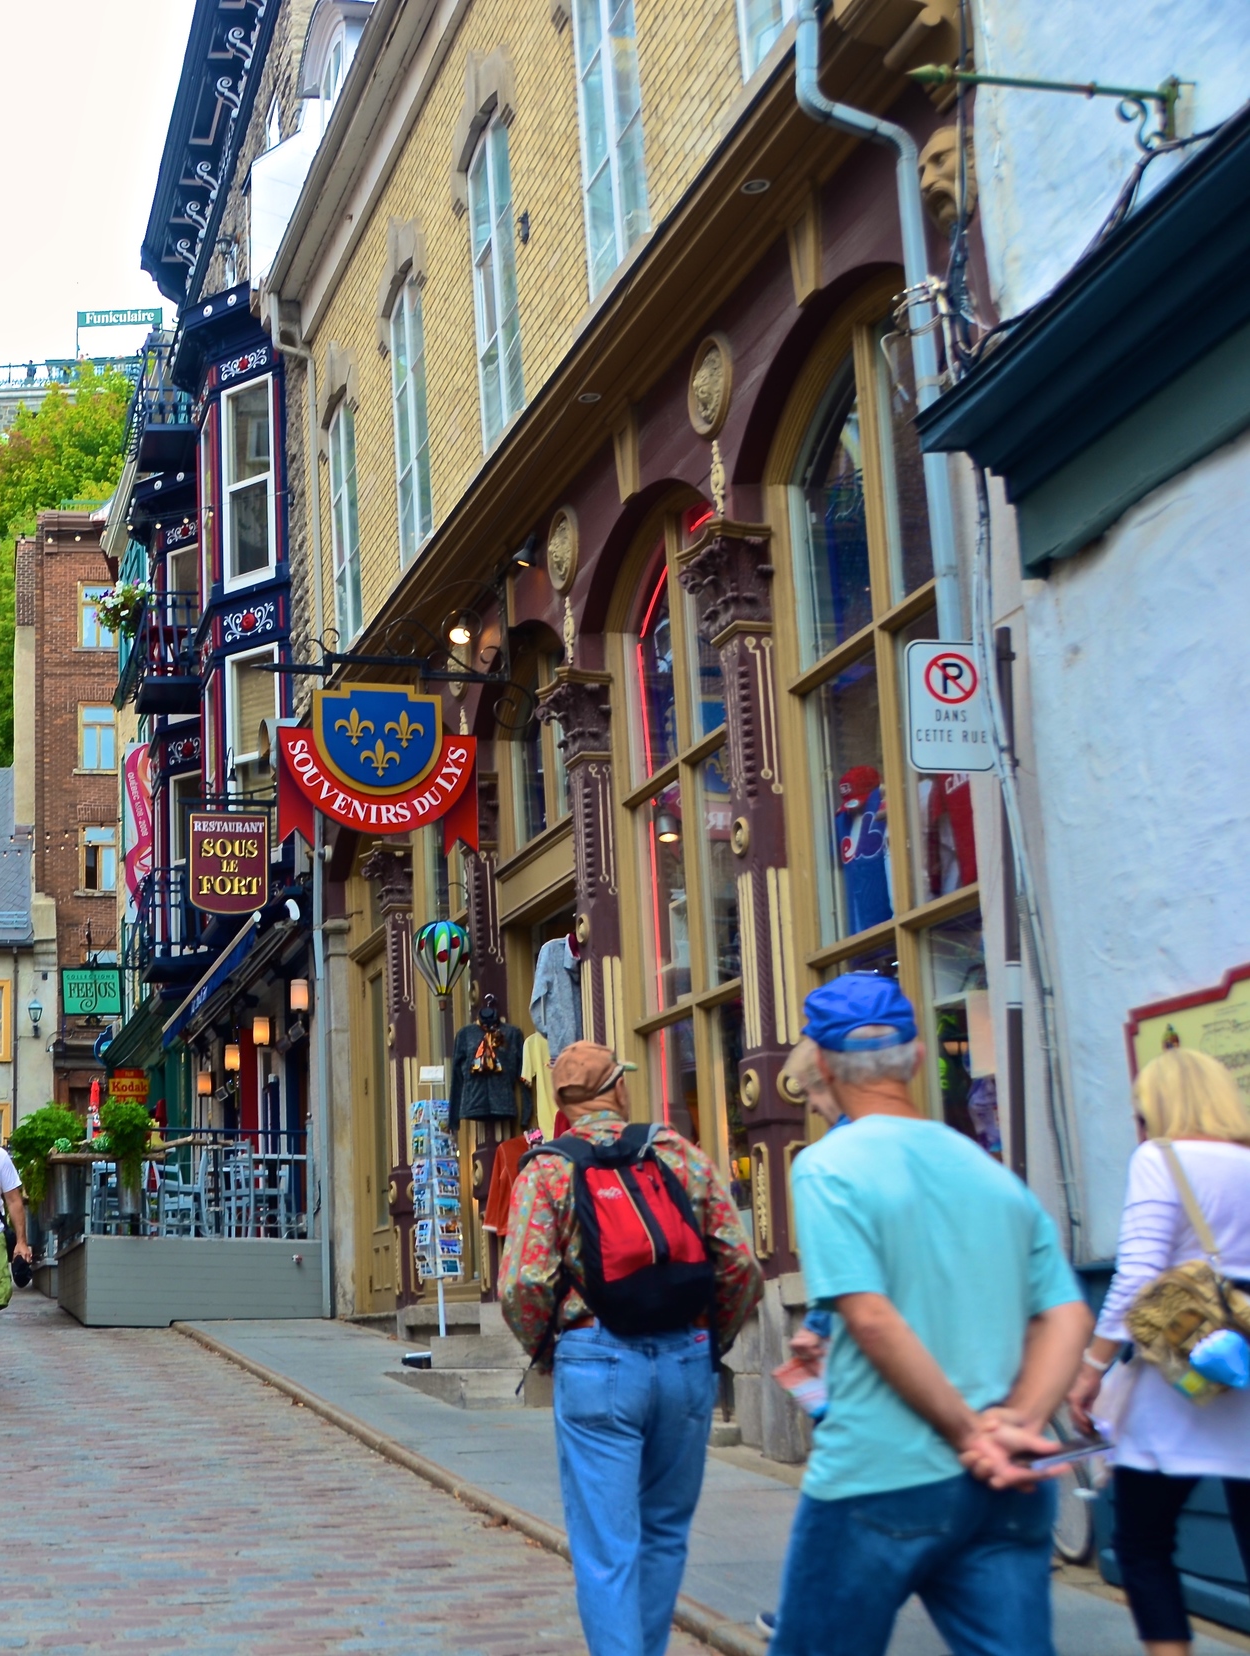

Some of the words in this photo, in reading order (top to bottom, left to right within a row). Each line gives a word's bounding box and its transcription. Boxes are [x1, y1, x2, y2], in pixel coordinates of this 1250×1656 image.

[85, 310, 155, 324] Funiculaire
[935, 708, 968, 722] DANS
[916, 728, 953, 742] CETTE
[962, 730, 988, 743] RUE
[288, 739, 412, 825] SOUVENIRS
[412, 788, 442, 816] DU
[440, 746, 468, 793] LYS
[193, 820, 264, 833] RESTAURANT
[201, 838, 258, 858] SOUS
[221, 859, 238, 873] LE
[198, 875, 262, 895] FORT
[111, 1080, 148, 1092] Kodak
